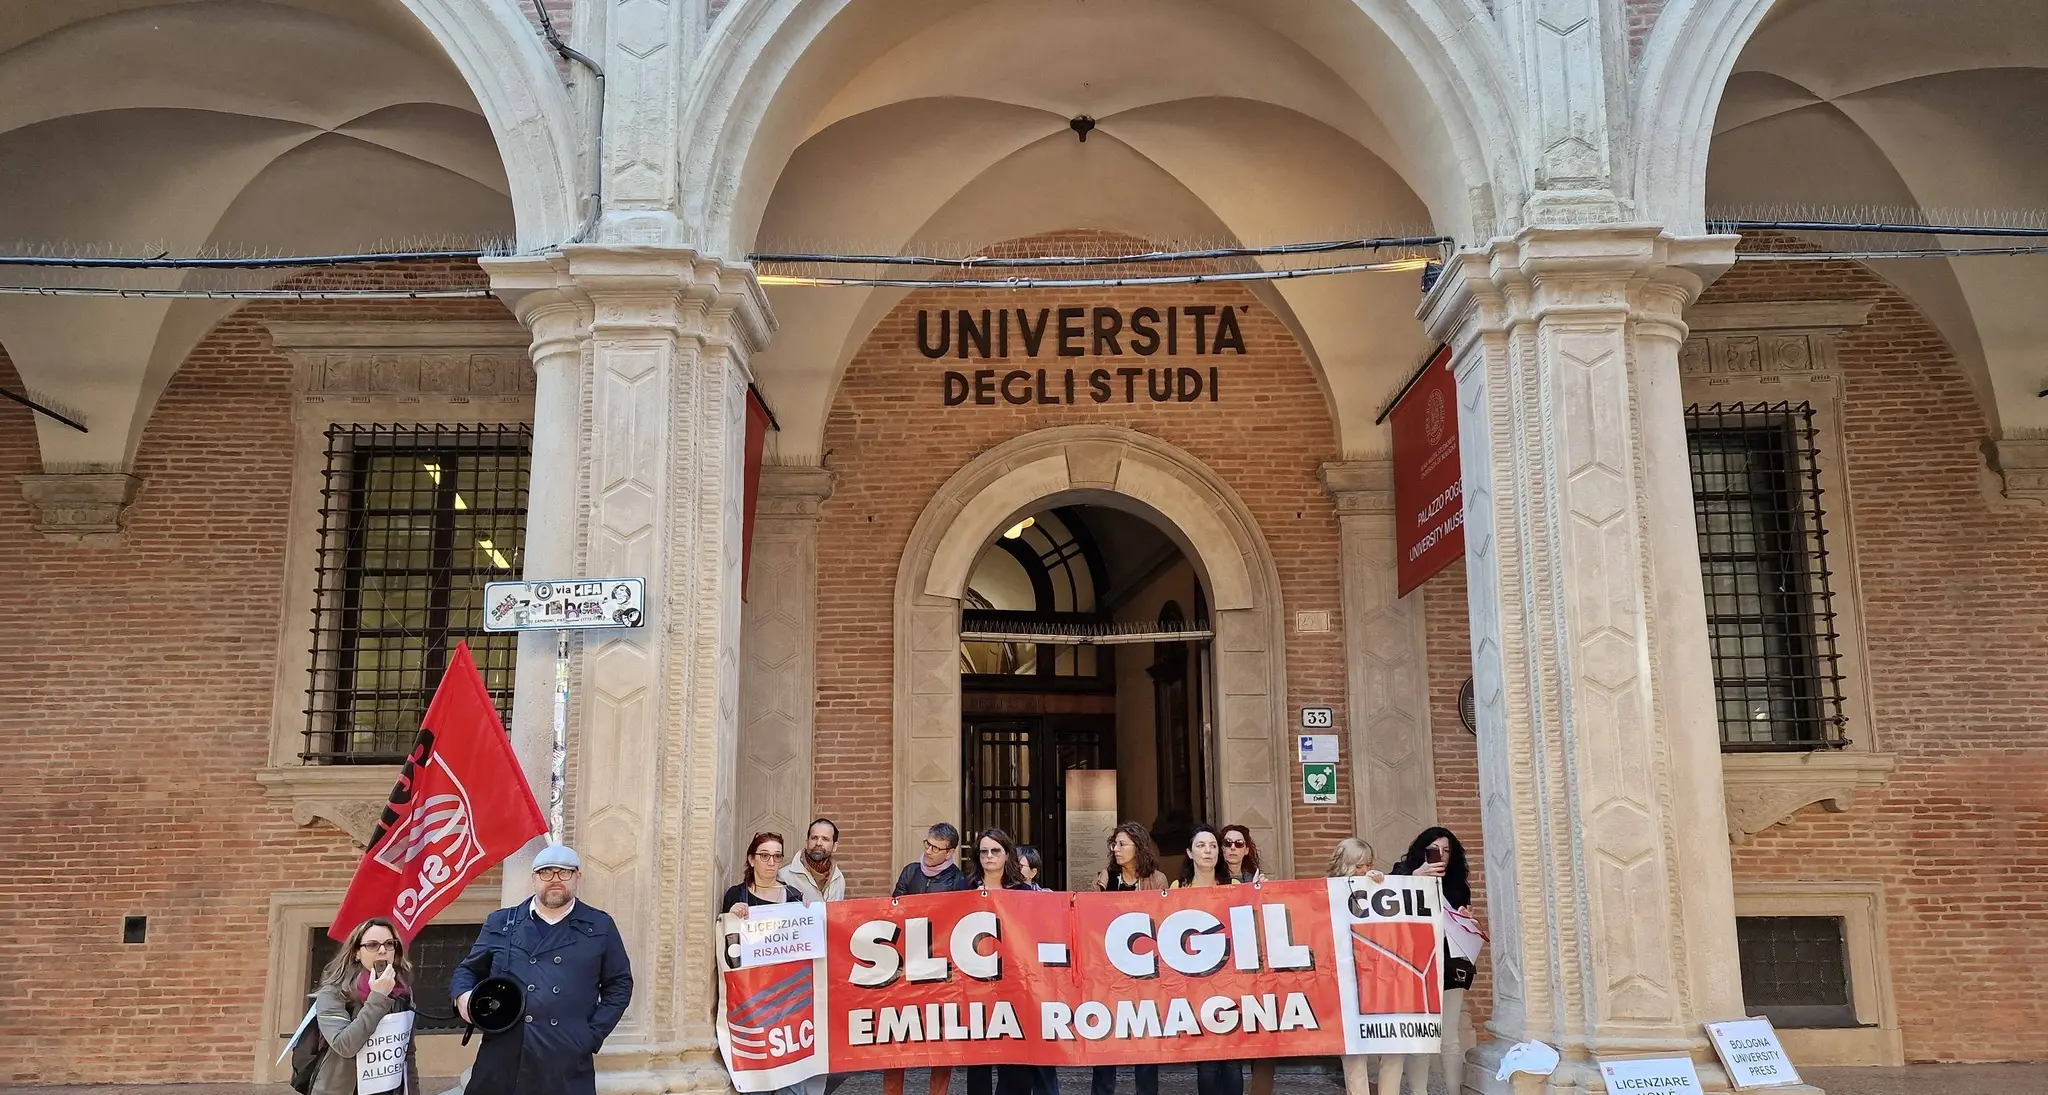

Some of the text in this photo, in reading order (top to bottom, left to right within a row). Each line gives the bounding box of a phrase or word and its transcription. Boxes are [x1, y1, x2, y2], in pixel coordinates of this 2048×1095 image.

[944, 366, 1219, 406] DEGLI STUDI
[1417, 493, 1445, 528] PALAZZO
[1409, 524, 1444, 561] UNIVERSITY
[555, 585, 571, 594] via
[1307, 712, 1327, 724] 33
[1348, 888, 1432, 918] CGIL
[747, 916, 814, 933] LICENZIARE
[764, 933, 789, 944] NON
[848, 911, 1000, 987] SLC
[1105, 903, 1314, 977] CGIL
[753, 942, 812, 958] RISANARE
[848, 992, 1319, 1046] EMILIA ROMAGNA
[768, 1019, 814, 1057] SLC
[1359, 1023, 1397, 1039] EMILIA
[1729, 1037, 1771, 1050] BOLOGNA
[1732, 1050, 1780, 1064] UNIVERSITY
[362, 1068, 374, 1079] AI
[1748, 1065, 1778, 1076] PRESS
[1614, 1076, 1690, 1090] LICENZIARE
